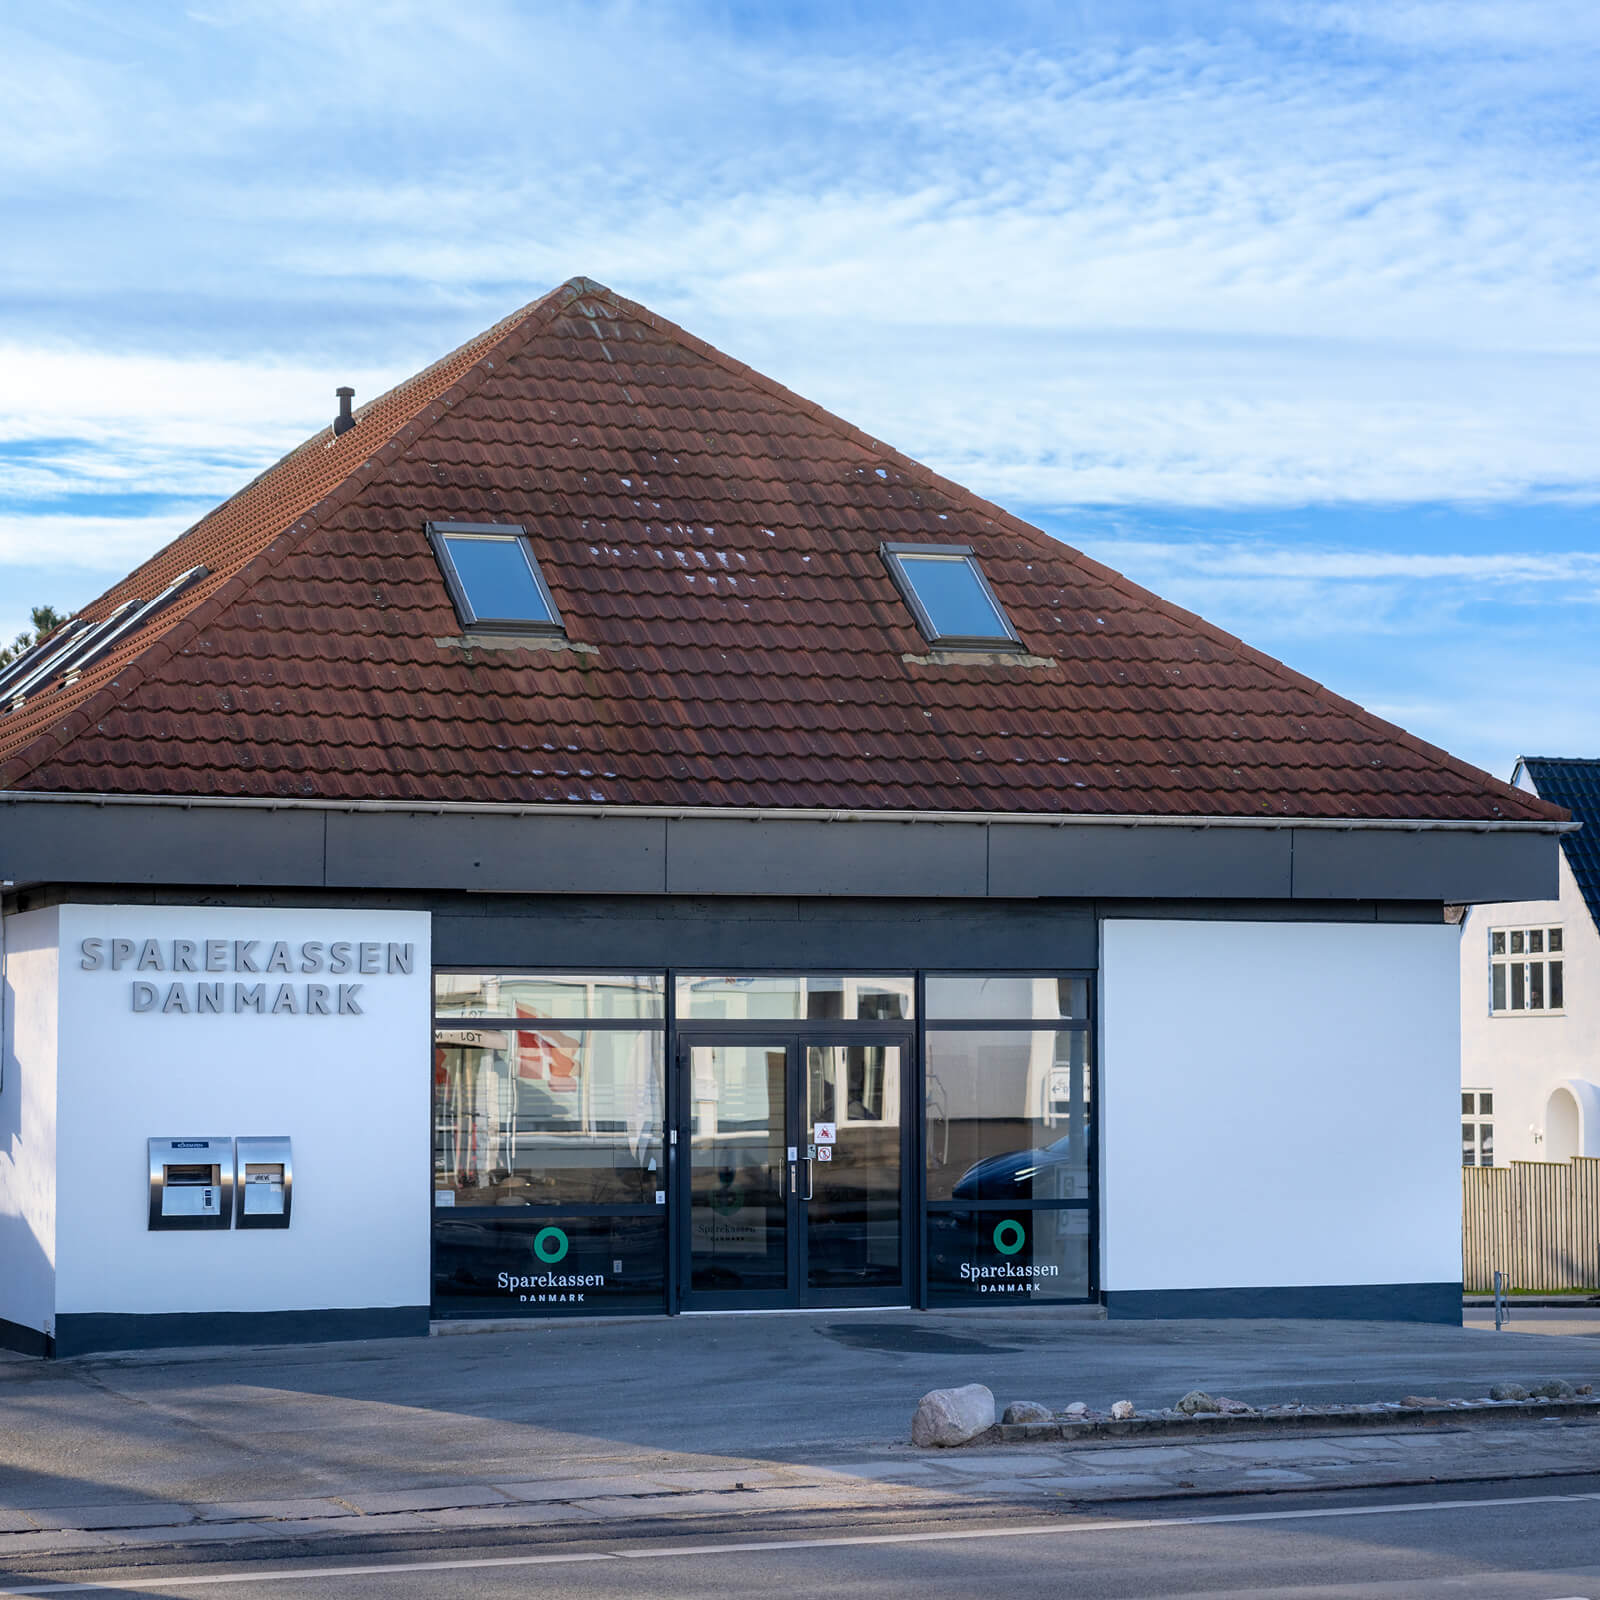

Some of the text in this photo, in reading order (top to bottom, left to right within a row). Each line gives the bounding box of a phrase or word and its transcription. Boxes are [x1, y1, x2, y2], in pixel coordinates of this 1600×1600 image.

[80, 937, 413, 975] SPAREKASSEN
[132, 980, 364, 1016] DANMARK
[497, 1271, 605, 1292] Sparekassen
[960, 1262, 1059, 1282] Sparekassen
[520, 1293, 585, 1303] DANMARK
[980, 1283, 1042, 1293] DANMARK
